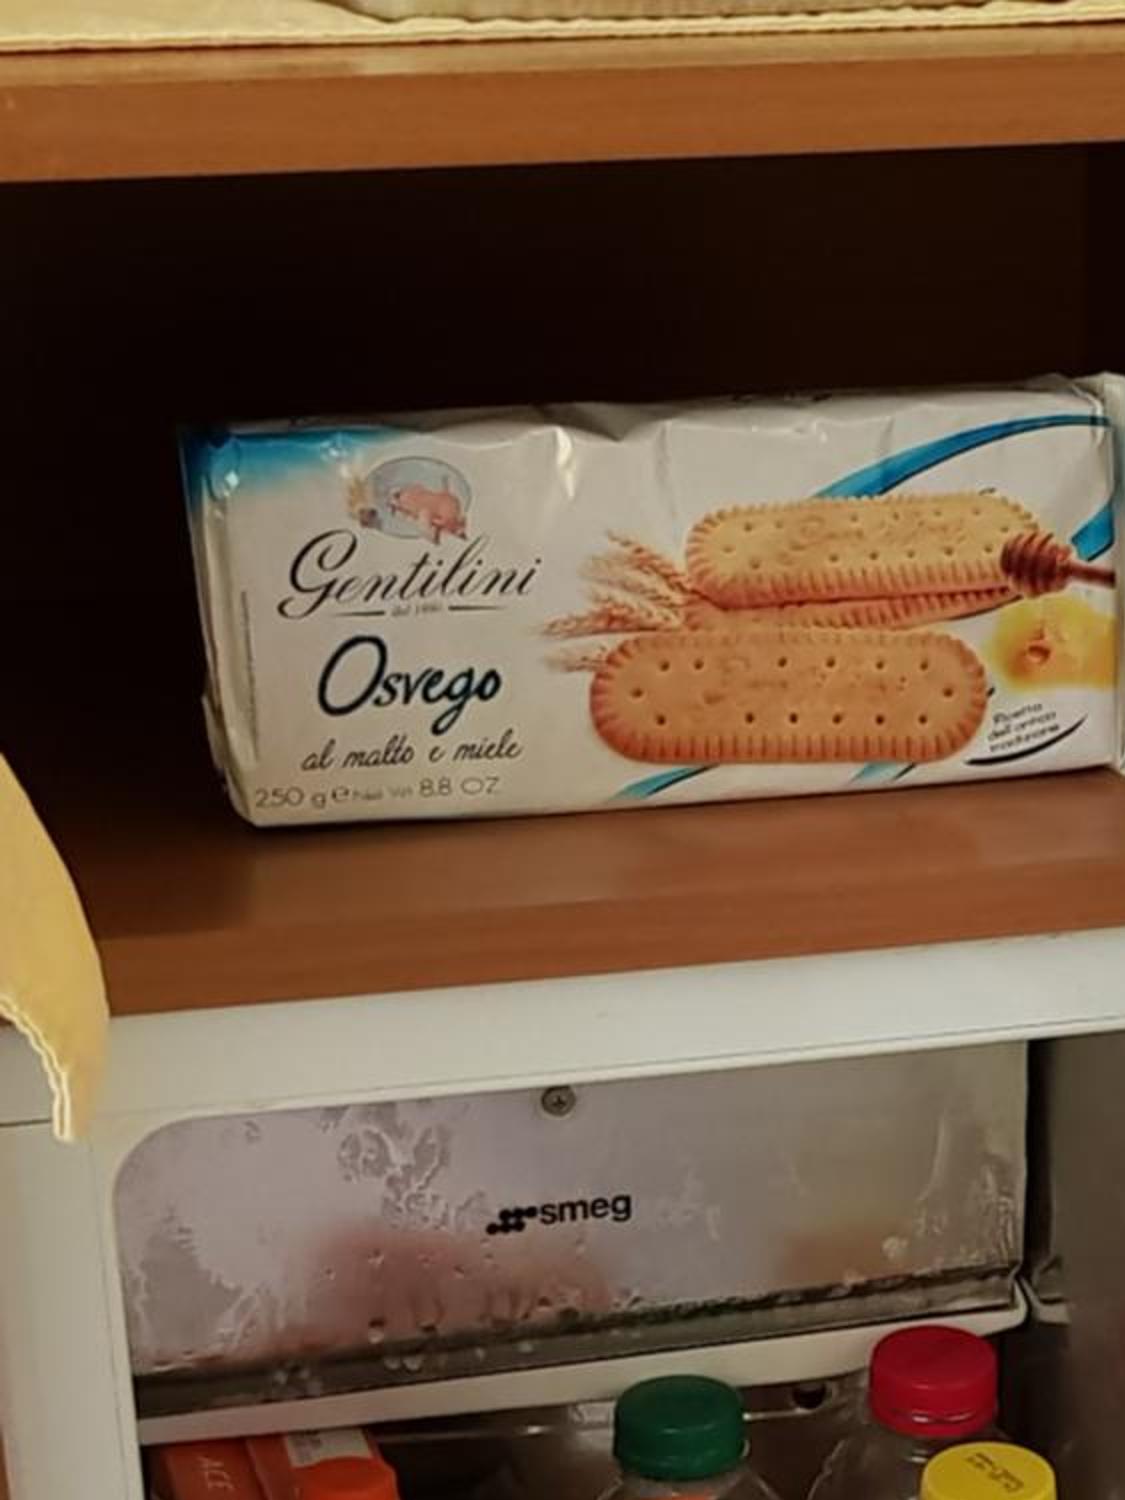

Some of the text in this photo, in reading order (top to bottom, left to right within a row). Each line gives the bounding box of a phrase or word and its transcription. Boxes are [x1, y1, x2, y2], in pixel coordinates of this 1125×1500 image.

[277, 529, 543, 620] Gentilini
[317, 635, 502, 736] Osvego
[301, 727, 523, 771] al malto e miele
[255, 786, 304, 809] 250
[540, 1194, 632, 1225] smeg
